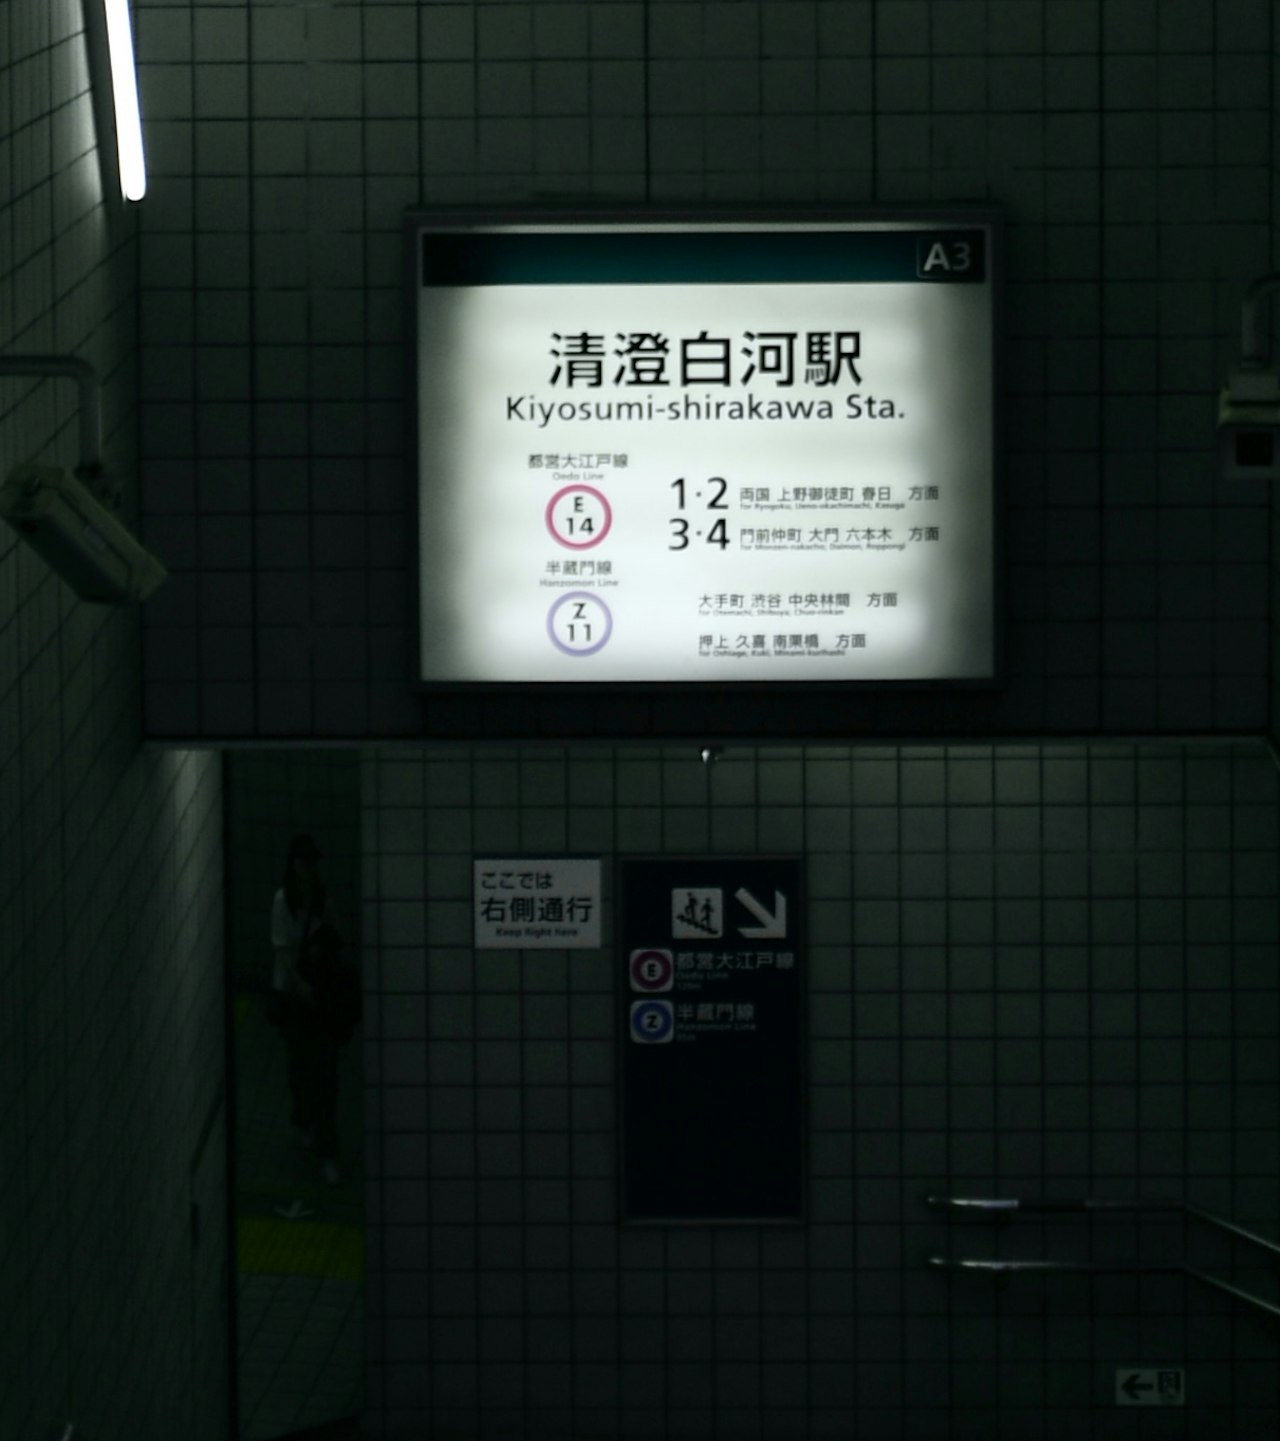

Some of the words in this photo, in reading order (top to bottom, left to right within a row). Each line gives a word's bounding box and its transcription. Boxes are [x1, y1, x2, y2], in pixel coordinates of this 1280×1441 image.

[923, 241, 972, 271] A3
[549, 331, 862, 387] 清澄白河駅
[506, 394, 833, 428] Kiyosumi-shirakawa
[846, 394, 905, 419] Sta.
[528, 453, 629, 469] 都営大江戸線
[908, 485, 939, 501] 方面
[573, 496, 584, 513] E
[566, 517, 595, 535] 14
[809, 527, 839, 542] 大門
[846, 527, 892, 542] 六本木
[908, 526, 940, 541] 方面
[699, 593, 744, 608] 大手町
[867, 592, 898, 607] 方面
[573, 603, 586, 619] Z
[567, 624, 592, 641] 11
[836, 634, 866, 649] 方面
[481, 873, 552, 889] ここでは
[481, 897, 592, 922] 右側通行
[648, 964, 657, 977] E
[647, 1015, 658, 1028] Z
